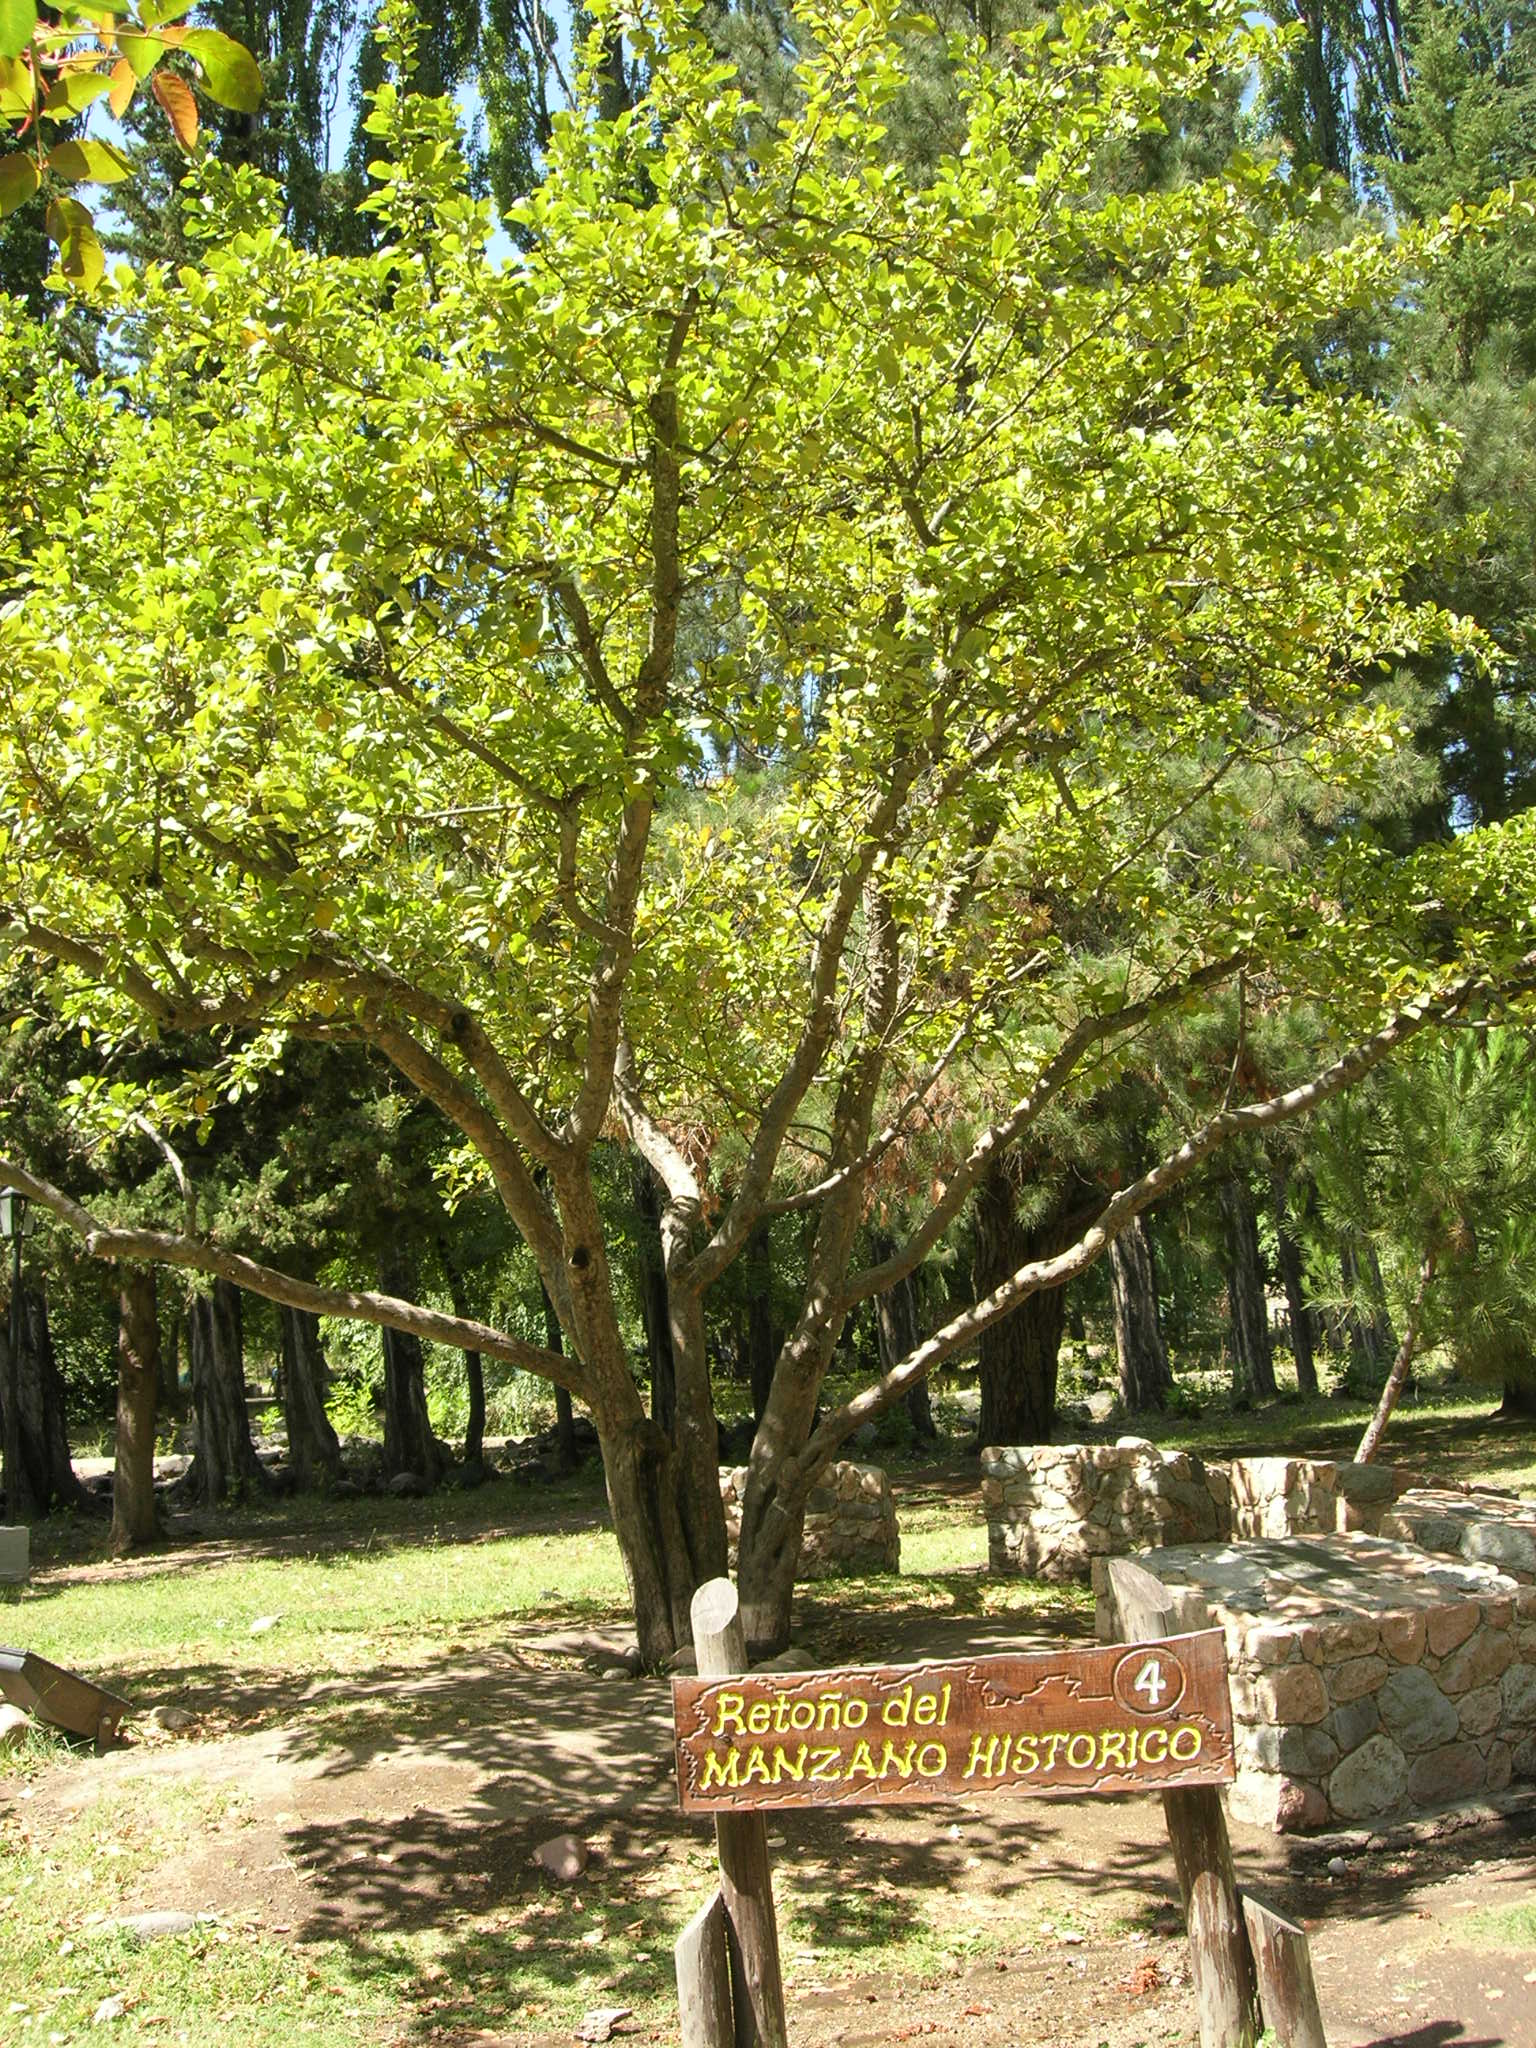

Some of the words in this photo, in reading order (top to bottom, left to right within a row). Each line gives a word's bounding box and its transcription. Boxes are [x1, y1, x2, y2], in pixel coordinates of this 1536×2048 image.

[1135, 1658, 1166, 1705] 4
[711, 1692, 868, 1738] Retoño
[881, 1682, 951, 1727] del
[699, 1742, 948, 1789] MANZANO
[962, 1727, 1203, 1778] HISTORICO
